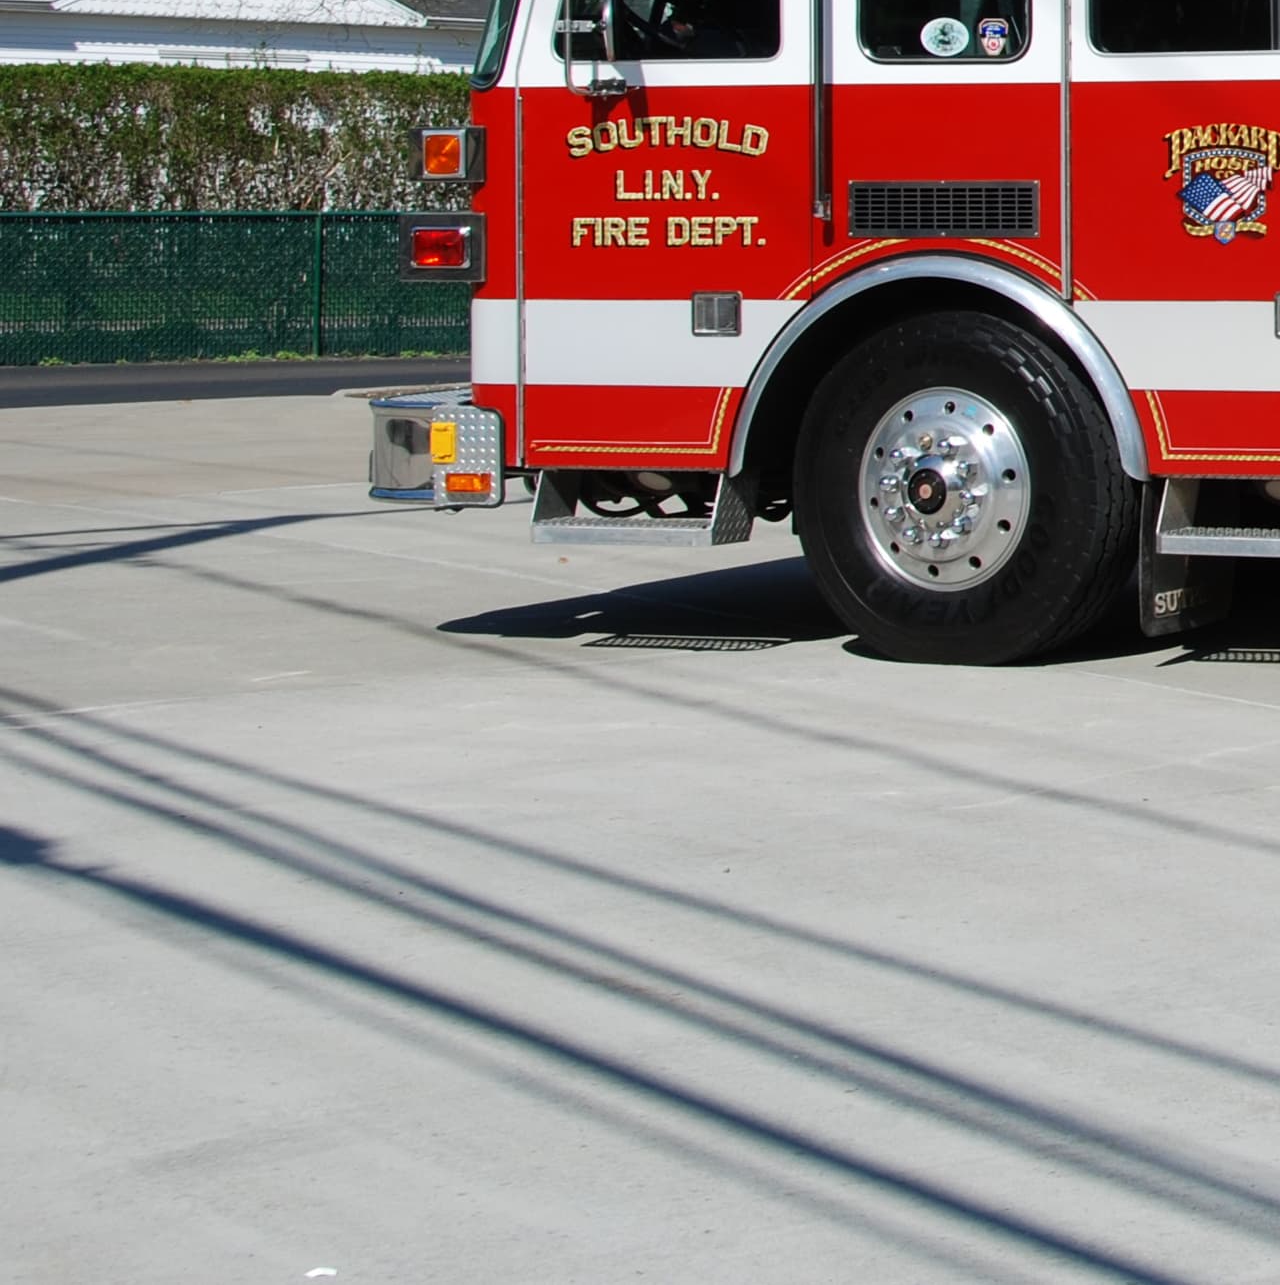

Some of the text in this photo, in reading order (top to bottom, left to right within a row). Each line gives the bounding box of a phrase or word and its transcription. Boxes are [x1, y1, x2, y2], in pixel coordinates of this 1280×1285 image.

[566, 115, 770, 158] SOUTHOLD
[571, 216, 767, 247] FIRE DEPT.
